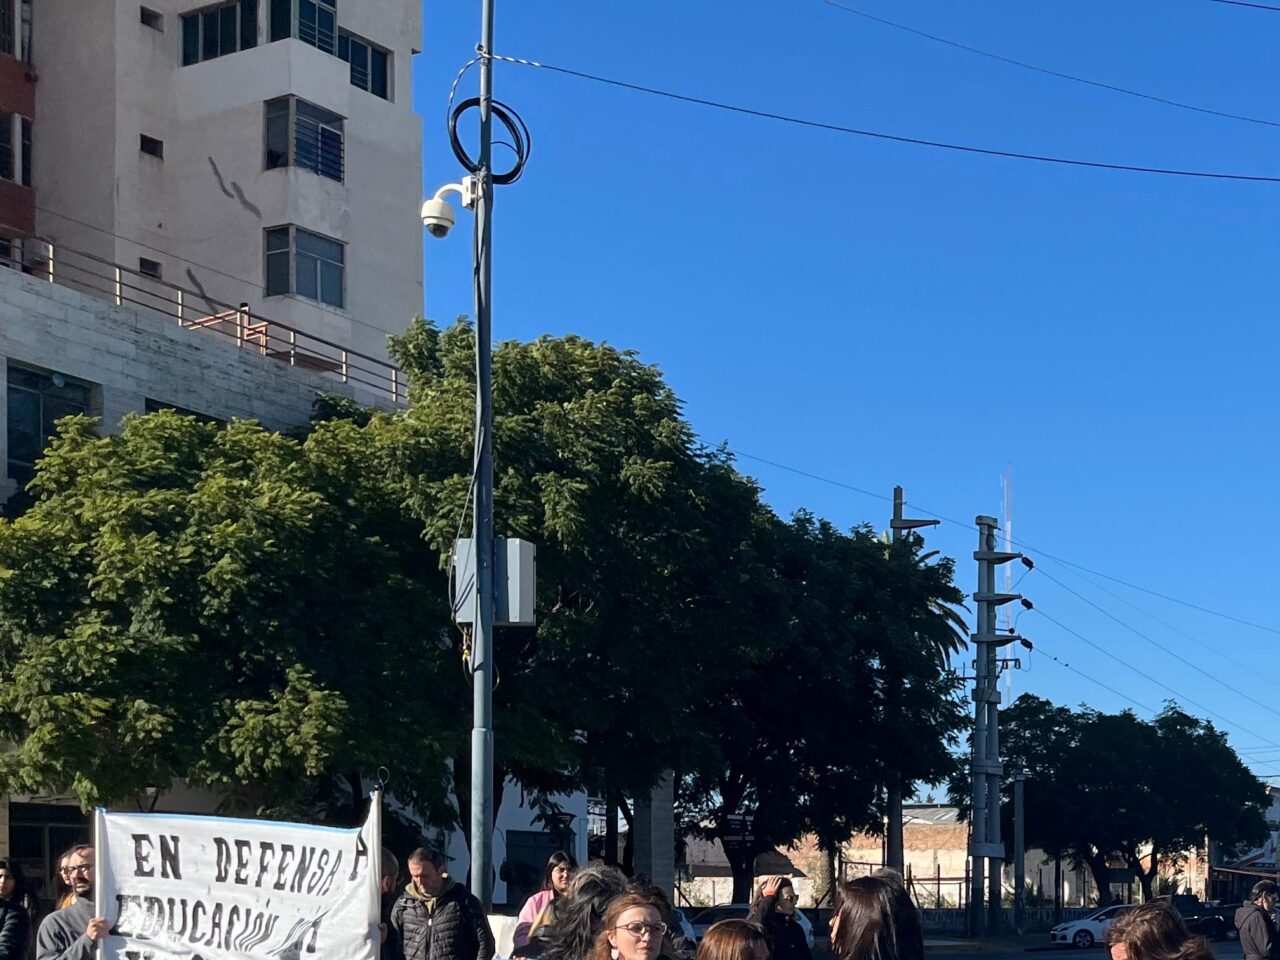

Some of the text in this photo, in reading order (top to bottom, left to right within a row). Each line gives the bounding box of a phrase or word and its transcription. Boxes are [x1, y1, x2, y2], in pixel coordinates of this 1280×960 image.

[131, 834, 182, 880] EN
[213, 836, 343, 896] DEFENSA
[109, 894, 280, 952] EDUCACIÓN
